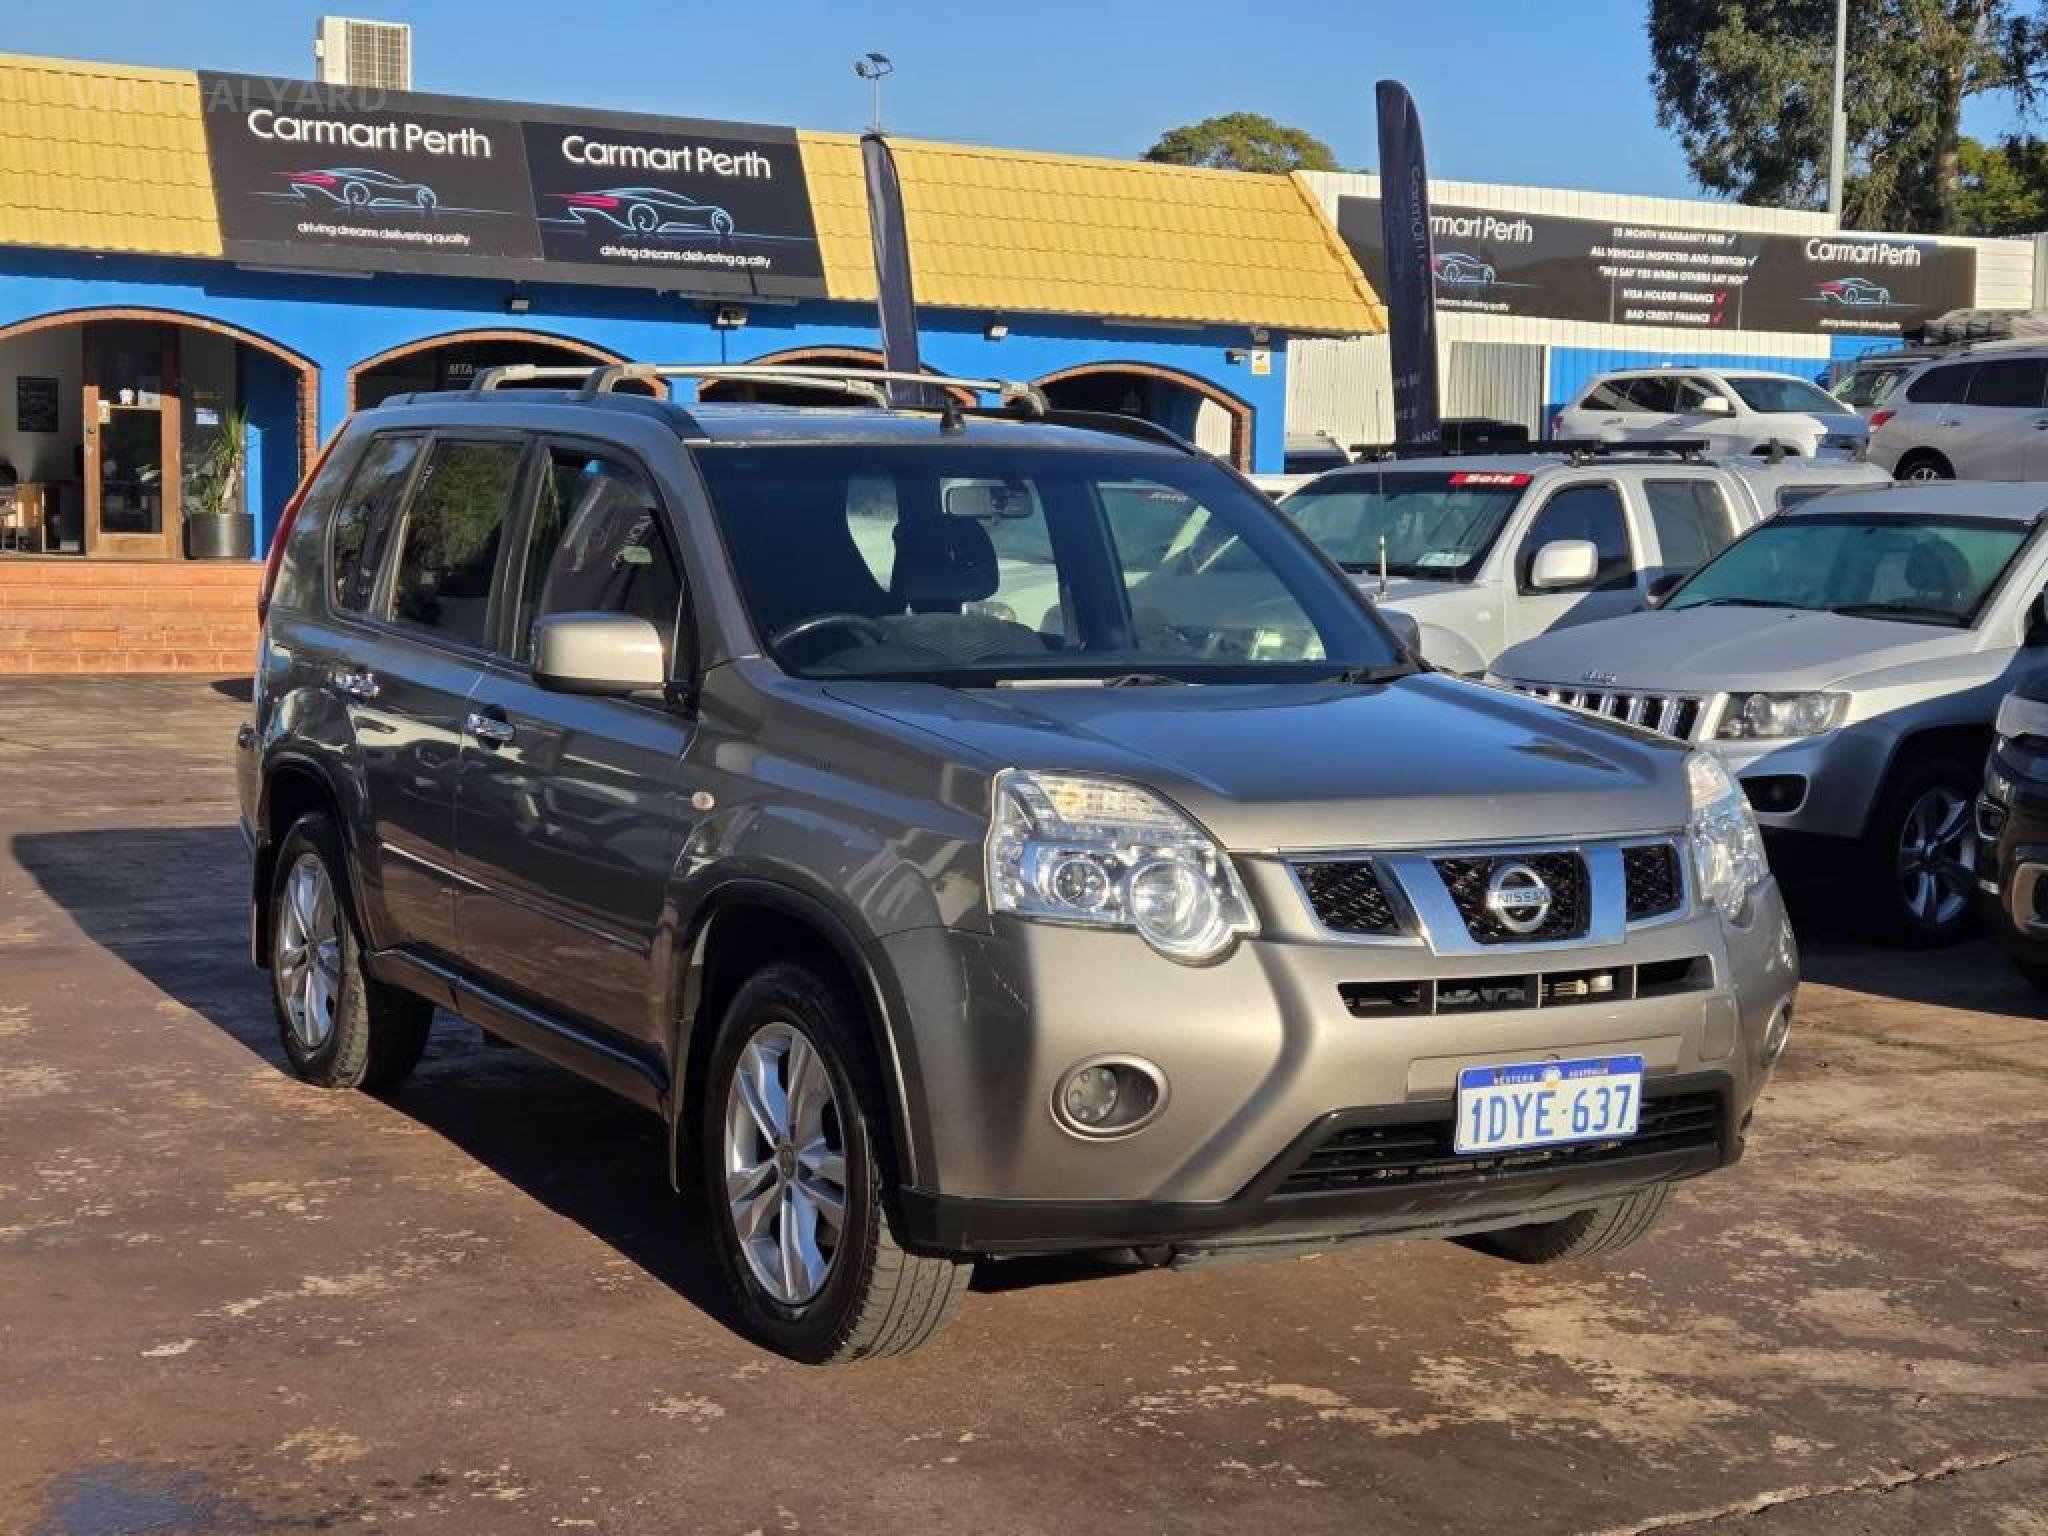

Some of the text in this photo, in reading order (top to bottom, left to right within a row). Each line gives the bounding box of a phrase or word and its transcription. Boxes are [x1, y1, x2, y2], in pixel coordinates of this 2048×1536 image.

[247, 108, 492, 158] Carmart Perth
[561, 135, 772, 179] Carmart Perth
[298, 222, 471, 246] driving dreams delivering quality
[1430, 215, 1533, 243] mart Perth
[600, 245, 771, 269] driving dreams delivering quality
[1806, 238, 1921, 267] Carmart Perth
